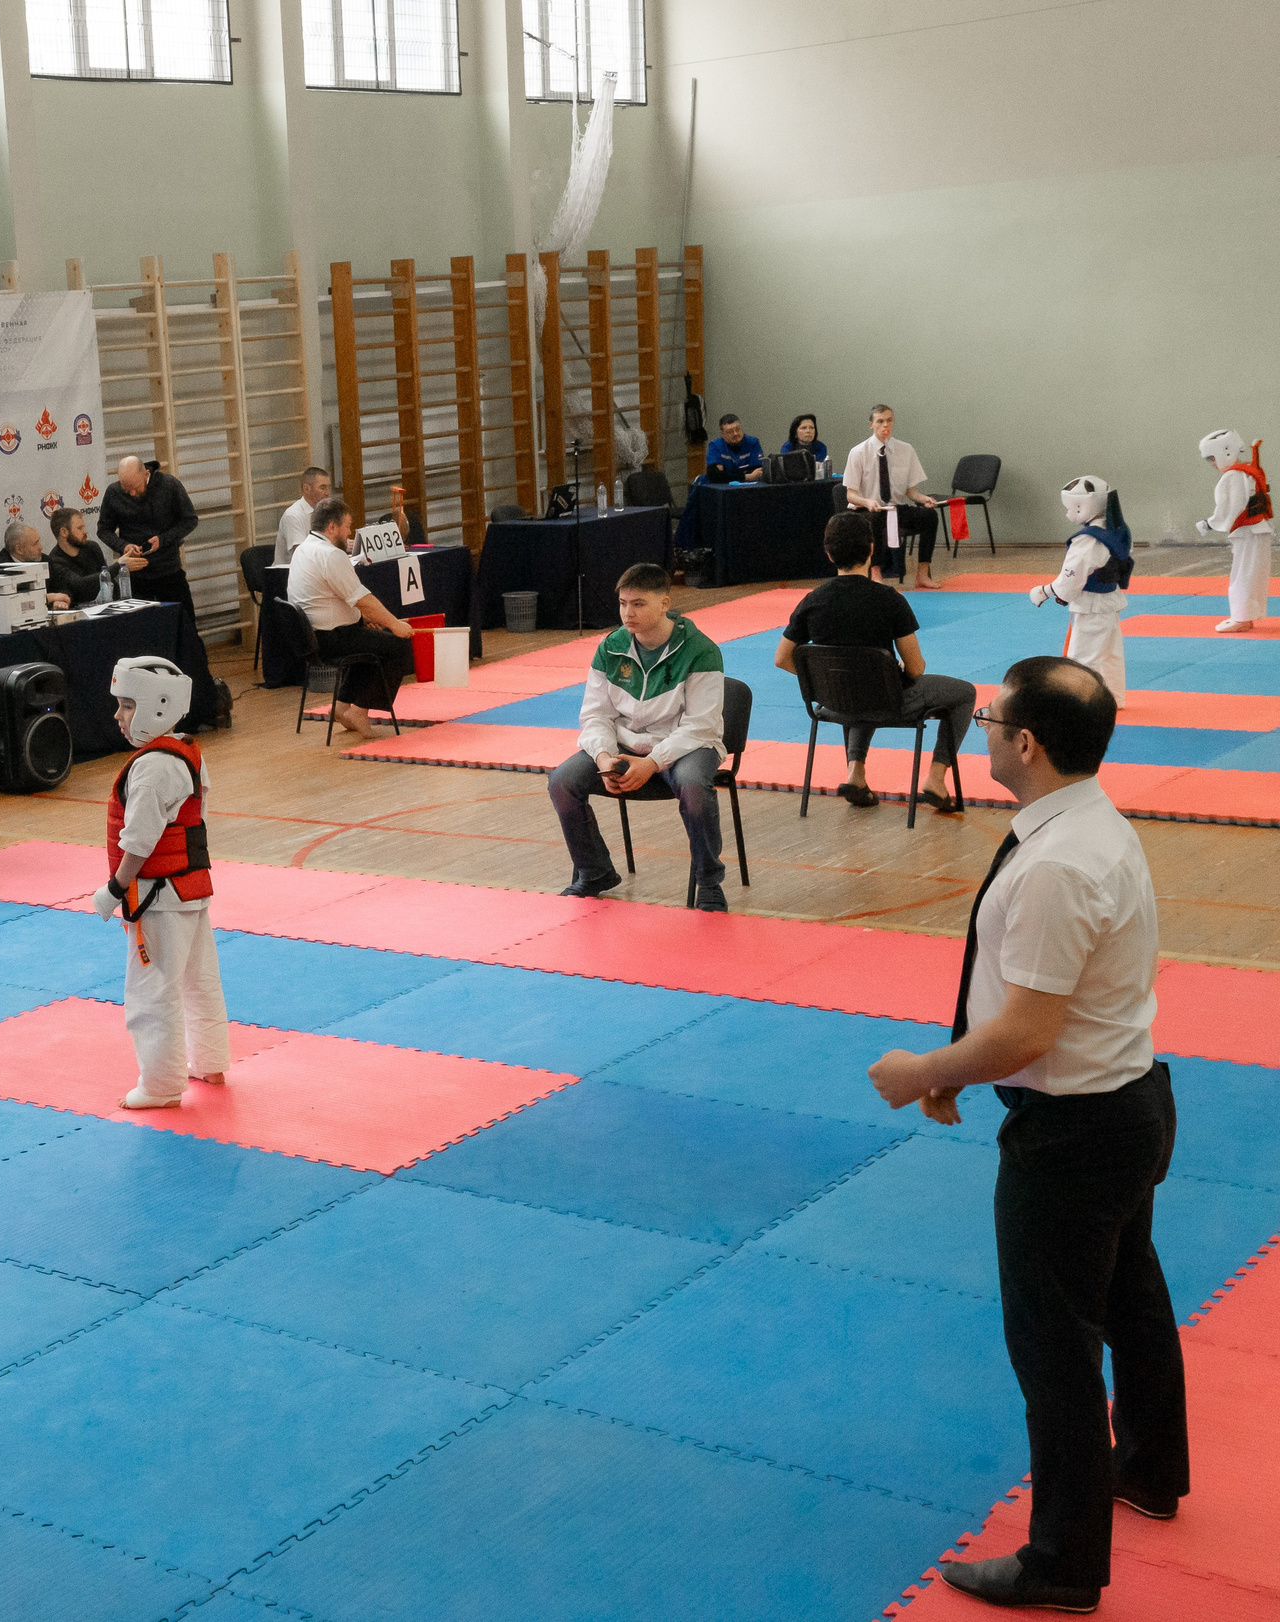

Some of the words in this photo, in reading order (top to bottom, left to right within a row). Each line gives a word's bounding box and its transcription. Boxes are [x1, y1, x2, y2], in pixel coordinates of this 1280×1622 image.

[37, 442, 58, 451] РНФКК
[365, 530, 403, 553] A032
[406, 566, 419, 592] A
